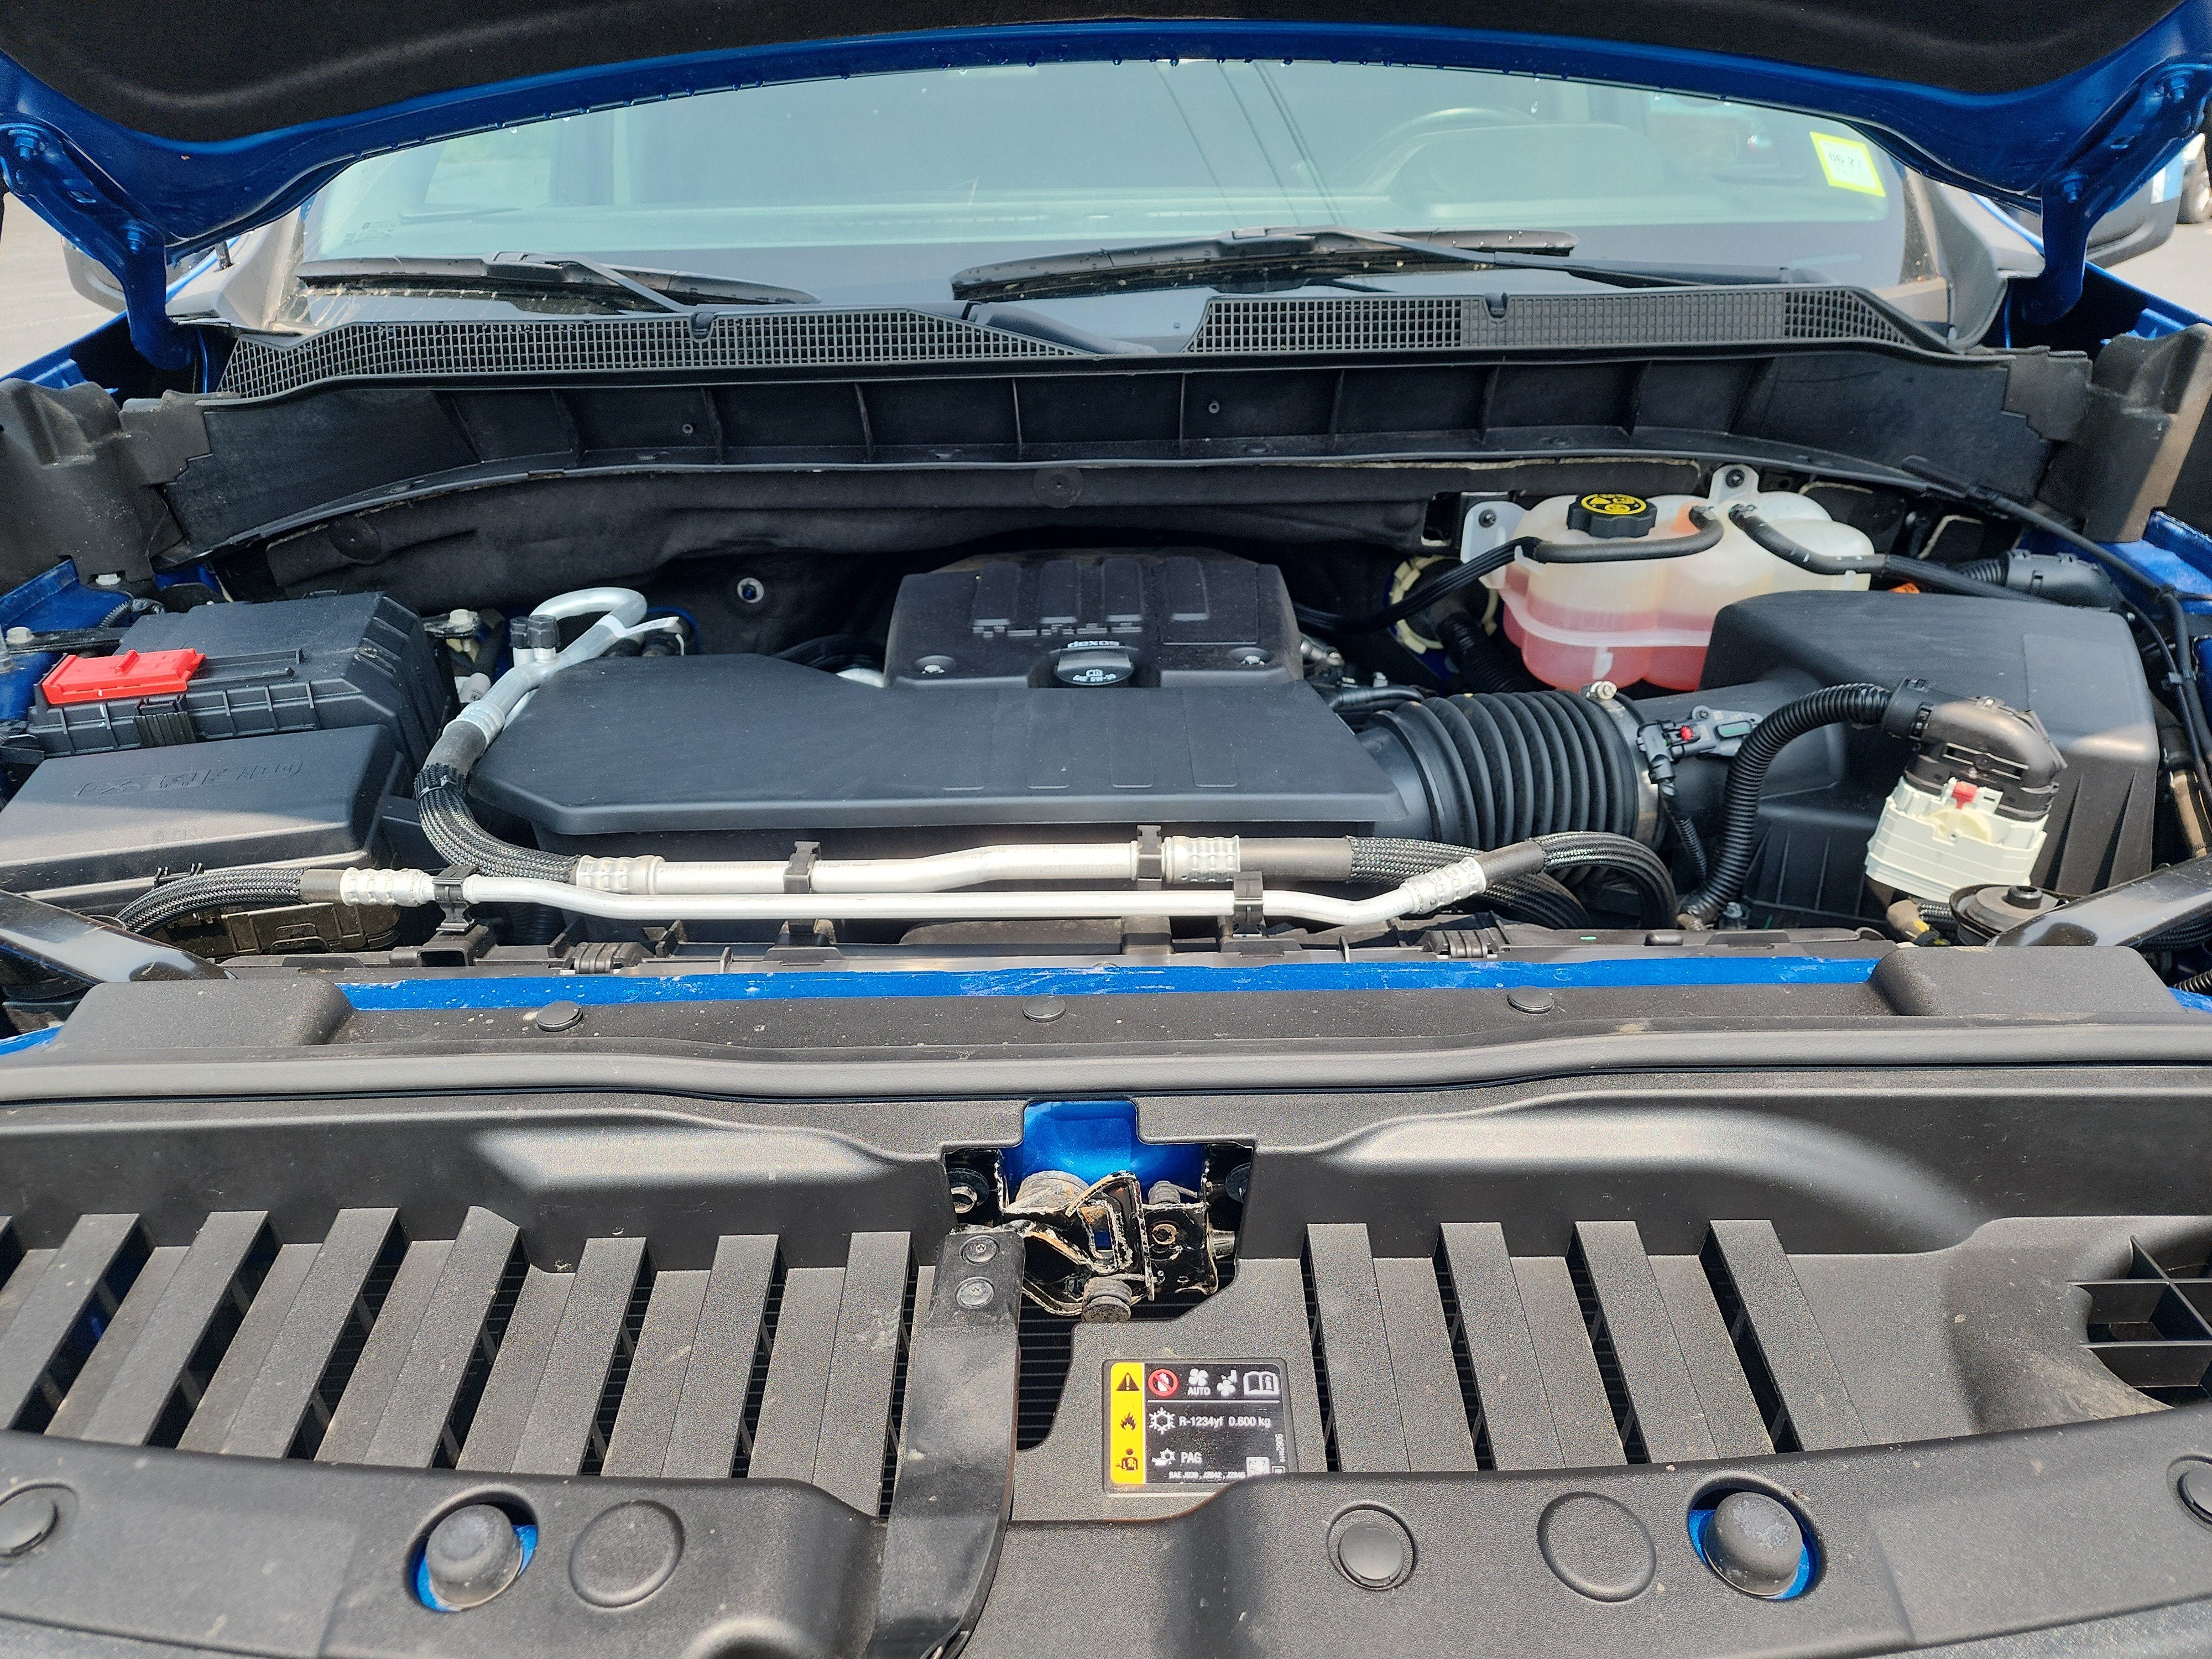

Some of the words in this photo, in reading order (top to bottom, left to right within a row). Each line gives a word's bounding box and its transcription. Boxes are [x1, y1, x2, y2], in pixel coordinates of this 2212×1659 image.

[1188, 1386, 1211, 1396] AUTO
[1179, 1416, 1224, 1429] R-1234yf
[1228, 1416, 1256, 1427] 0.600
[1258, 1416, 1271, 1428] kg
[1181, 1452, 1202, 1464] PAG
